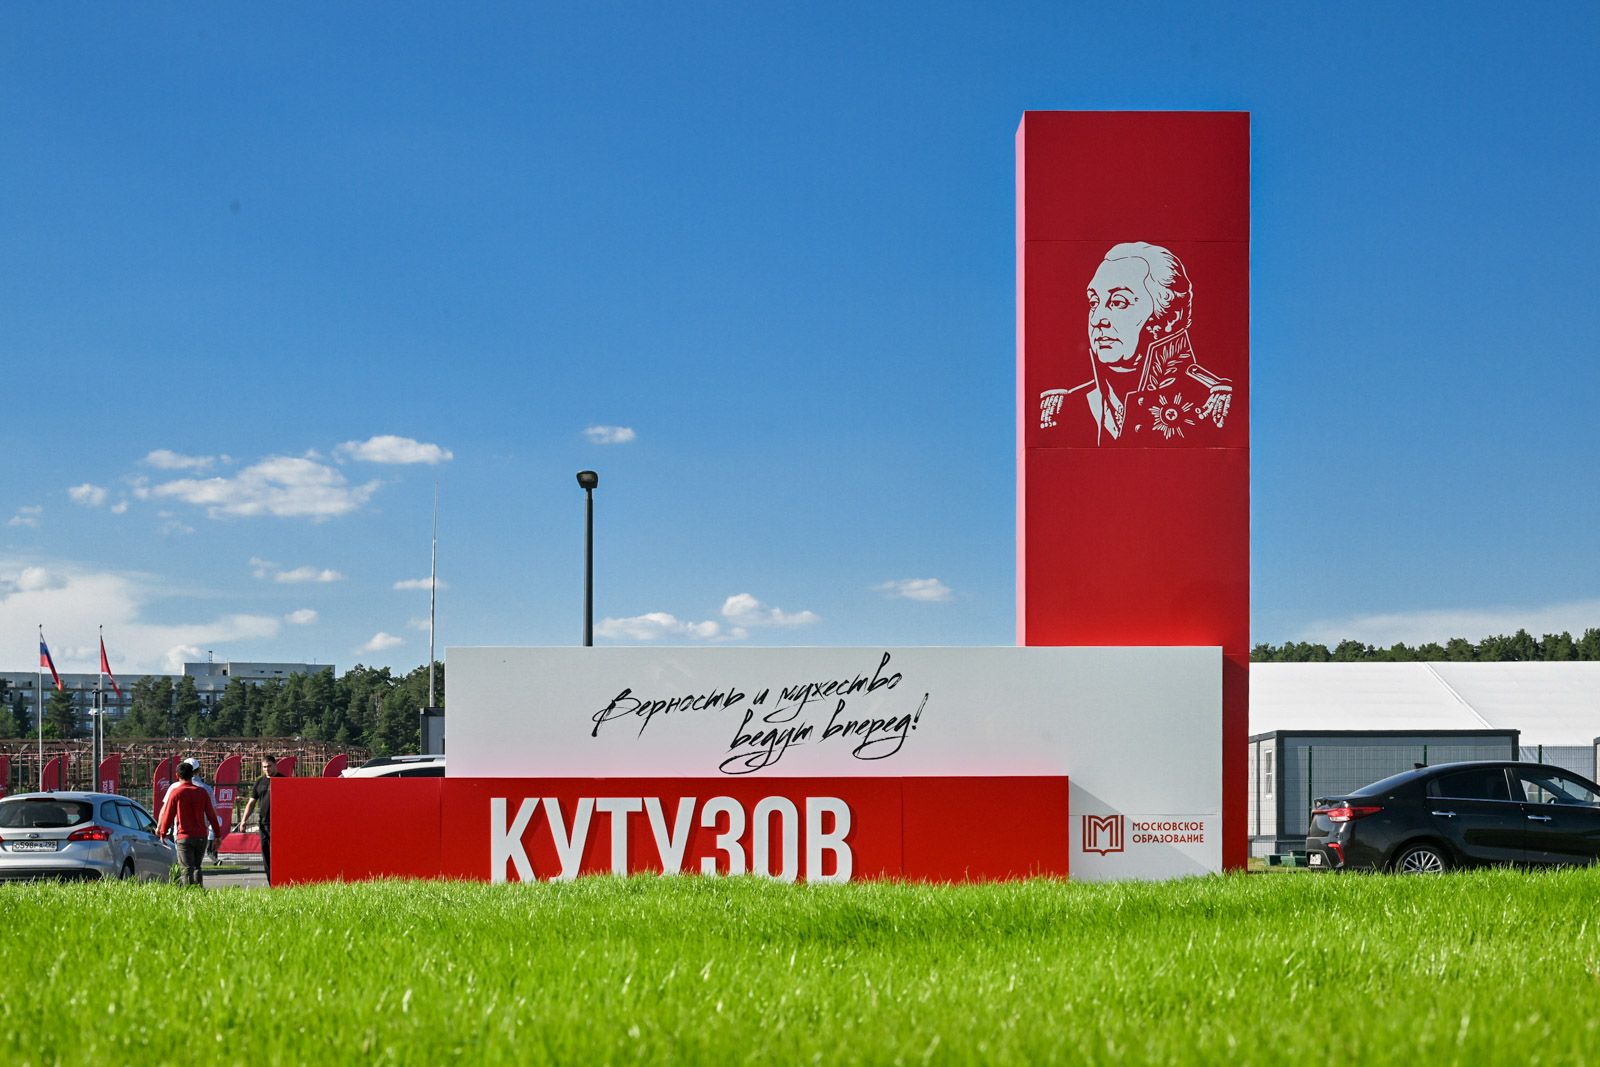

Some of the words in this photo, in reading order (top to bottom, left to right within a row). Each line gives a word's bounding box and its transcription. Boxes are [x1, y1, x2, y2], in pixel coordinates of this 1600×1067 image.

[592, 688, 745, 737] Верность
[753, 688, 769, 705] и
[719, 709, 814, 775] ведут
[490, 796, 852, 883] КУТУЗОВ
[1132, 821, 1204, 831] МОСКОВСКОЕ
[1132, 833, 1204, 844] ОБРАЗОВАНИЕ
